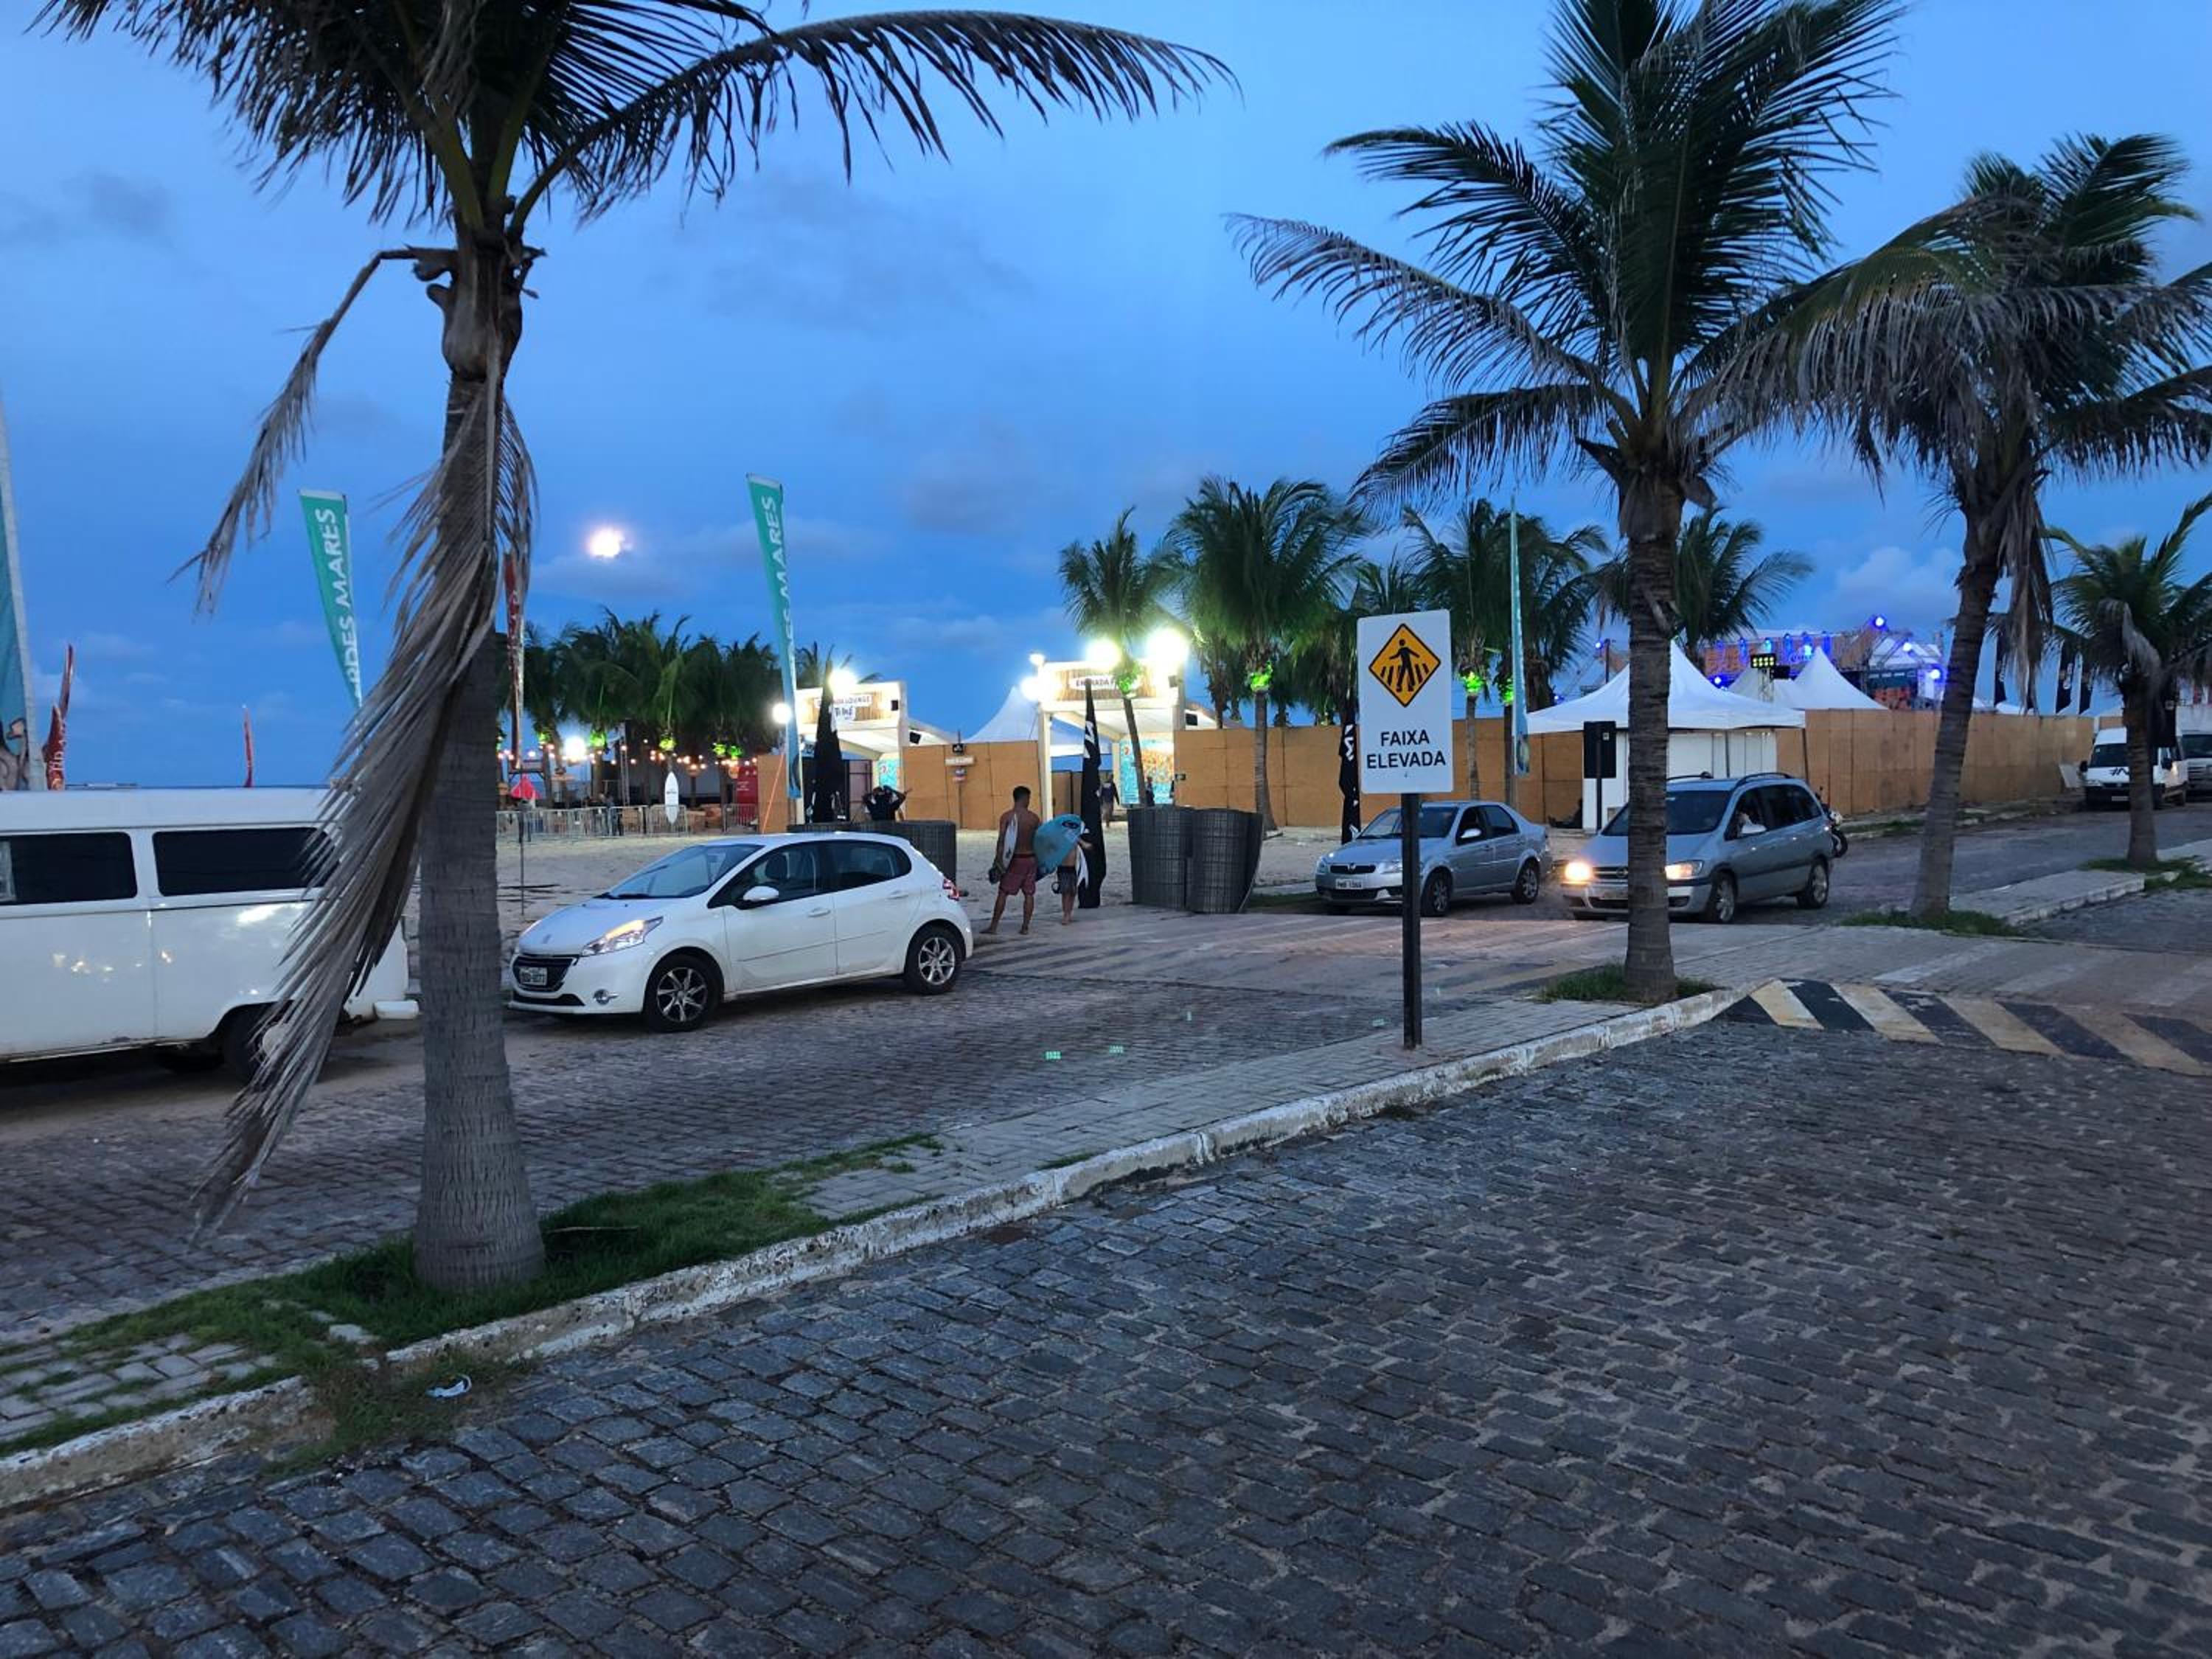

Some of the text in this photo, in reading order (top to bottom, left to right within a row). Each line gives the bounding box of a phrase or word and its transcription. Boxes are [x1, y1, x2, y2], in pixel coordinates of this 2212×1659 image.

[314, 507, 351, 609] MARES
[1380, 730, 1430, 746] FAIXA
[1366, 751, 1446, 768] ELEVADA
